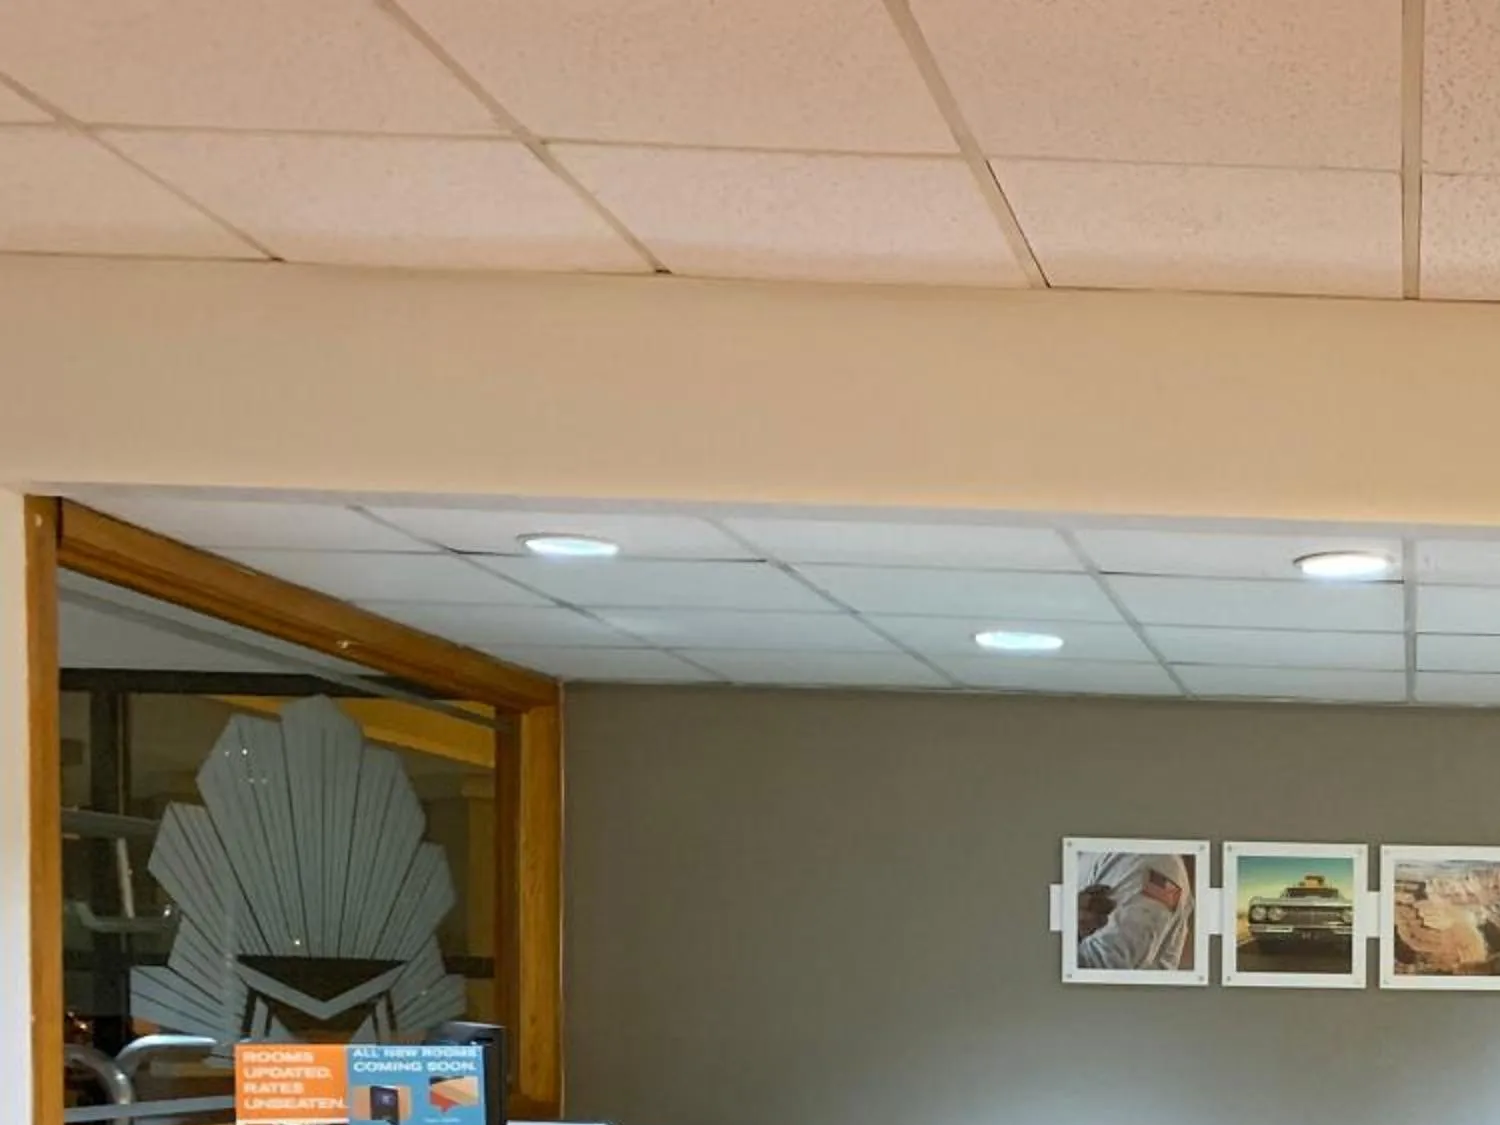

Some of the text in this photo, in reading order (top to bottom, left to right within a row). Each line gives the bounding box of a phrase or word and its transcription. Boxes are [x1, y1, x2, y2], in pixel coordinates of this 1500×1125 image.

[242, 1051, 314, 1064] ROOMS
[353, 1047, 381, 1057] ALL
[353, 1060, 422, 1072] COMING
[243, 1081, 304, 1094] RATES
